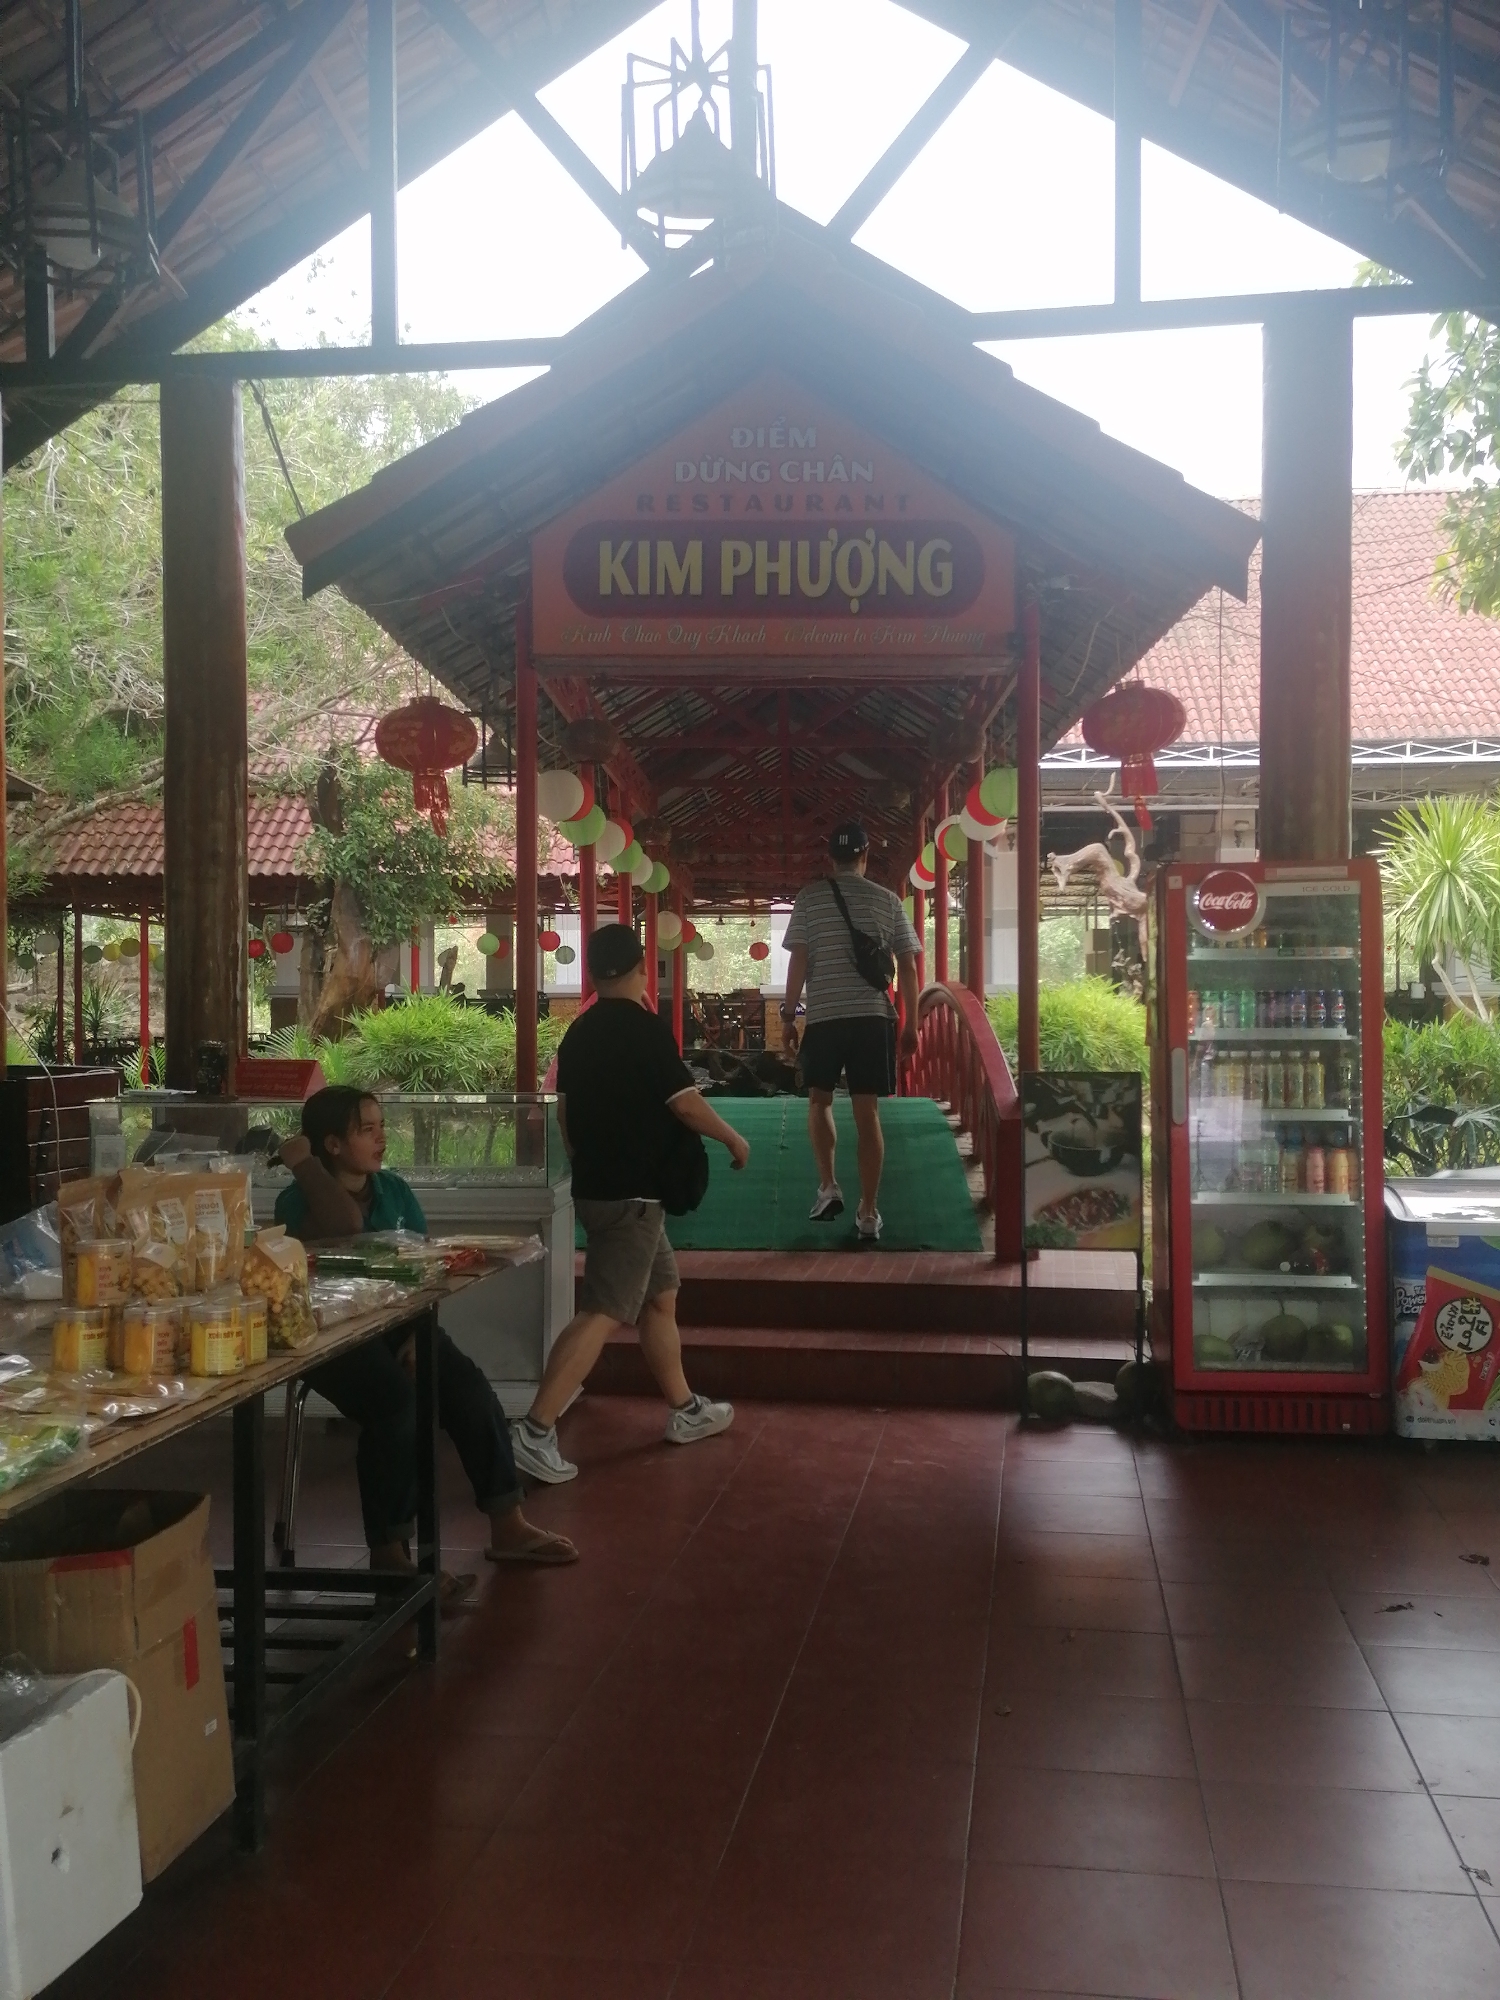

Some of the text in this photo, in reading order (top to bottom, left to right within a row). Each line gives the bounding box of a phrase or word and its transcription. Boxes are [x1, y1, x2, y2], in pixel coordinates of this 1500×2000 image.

[729, 416, 817, 448] ĐIỂM
[674, 453, 875, 484] DỪNG CHÂN
[635, 493, 912, 513] RESTAURANT
[599, 527, 954, 614] KIM PHƯỢNG
[784, 624, 850, 645] Welcome
[853, 627, 867, 645] to
[870, 624, 917, 645] Kim
[1302, 885, 1351, 893] ICE COLD
[1199, 891, 1254, 911] Coca-Cola
